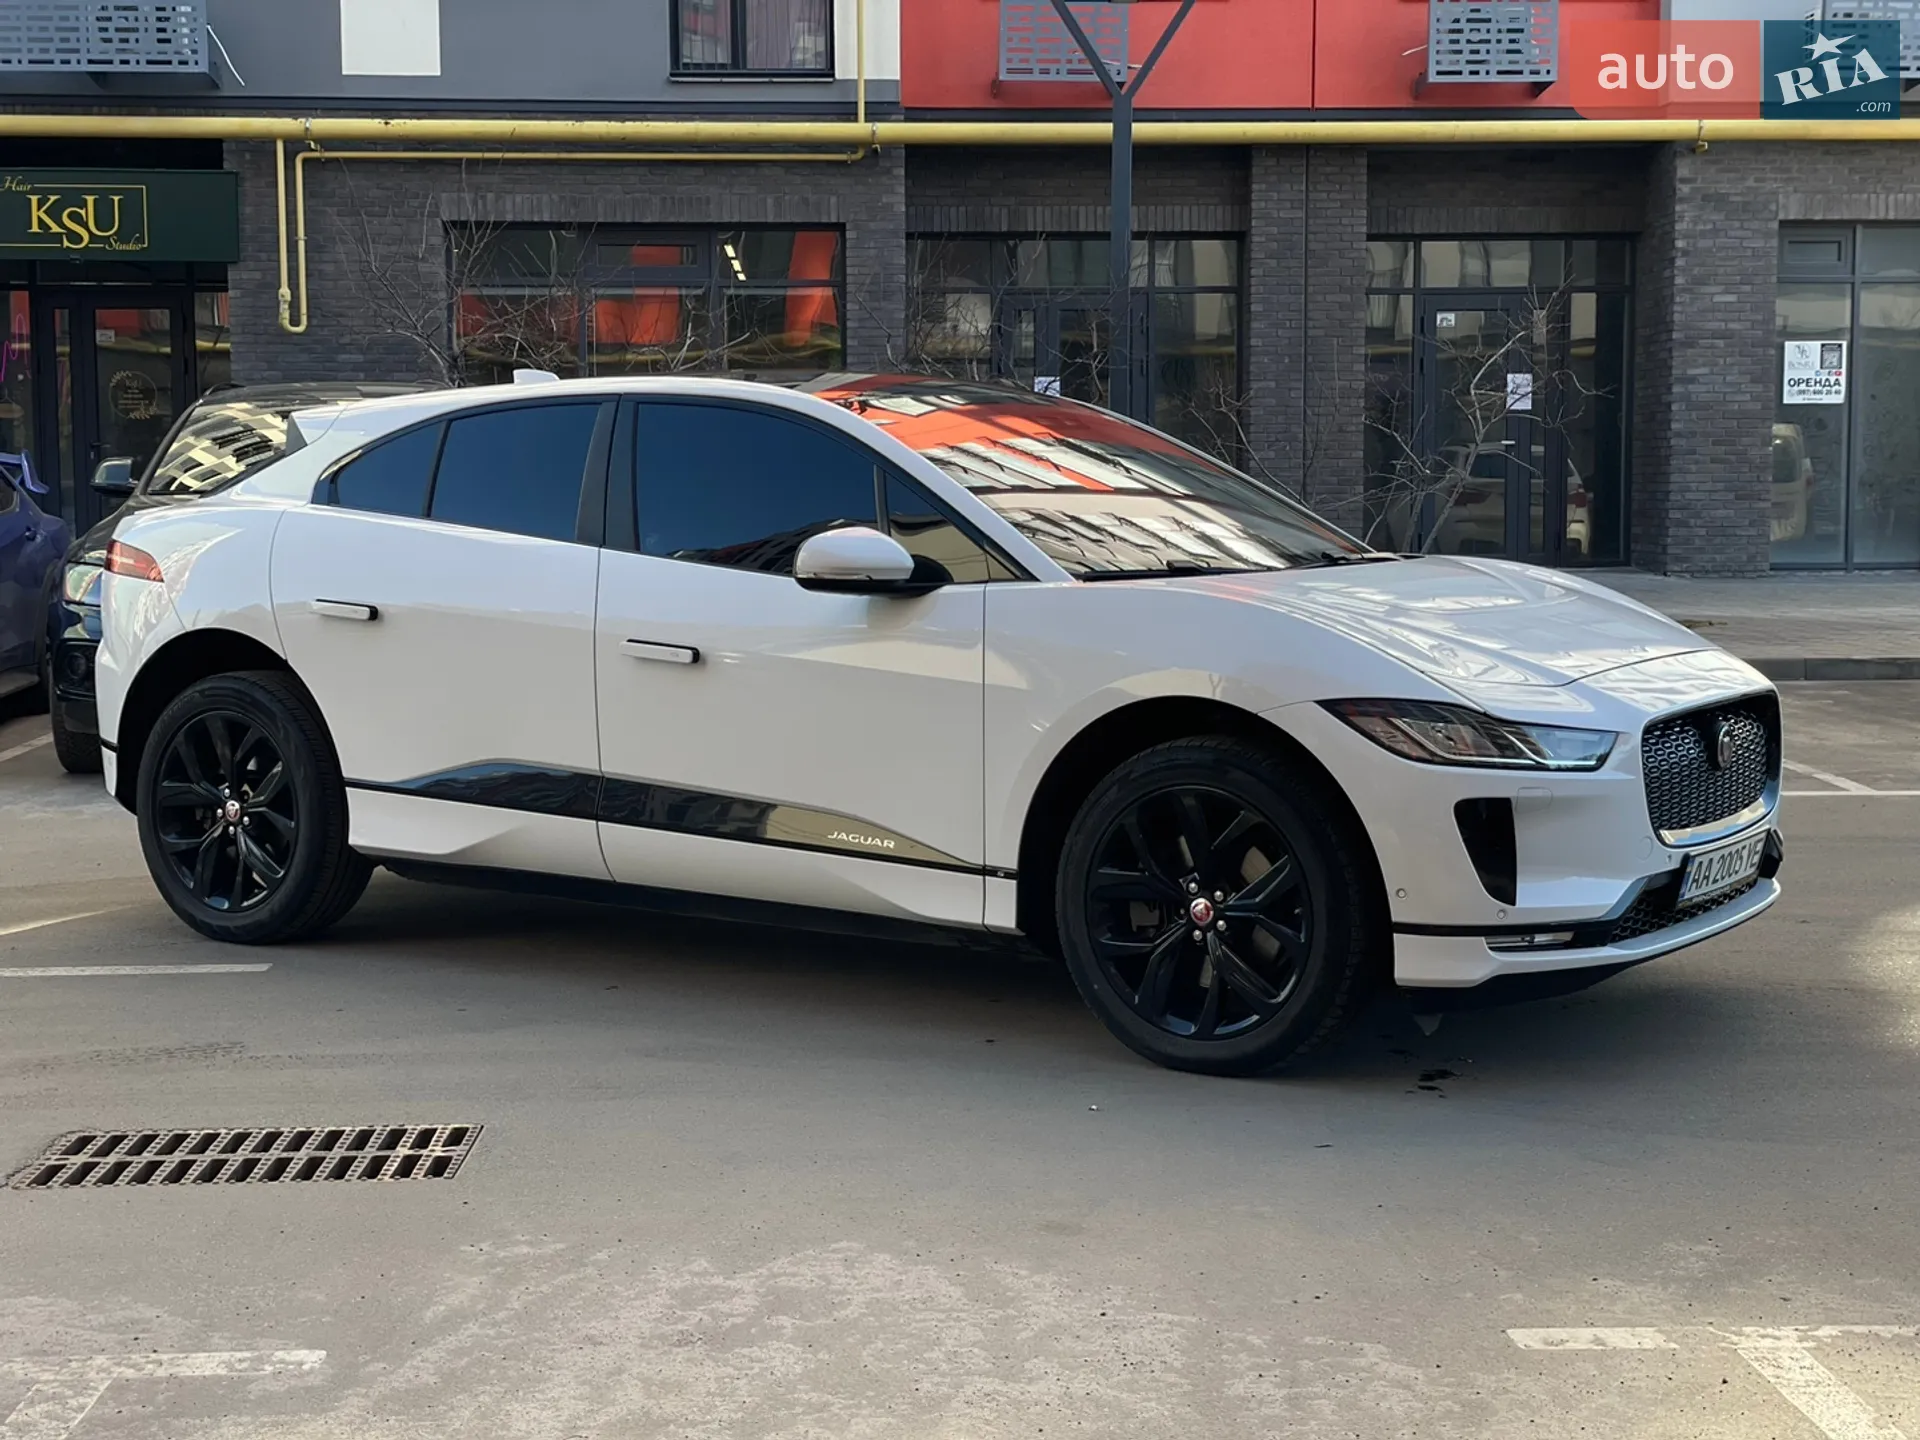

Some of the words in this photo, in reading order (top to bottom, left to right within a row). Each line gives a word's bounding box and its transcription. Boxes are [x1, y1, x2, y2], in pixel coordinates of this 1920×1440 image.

[0, 176, 32, 192] Hair
[26, 194, 124, 249] KSU
[105, 233, 142, 251] Studio
[1788, 377, 1841, 388] ОРЕНДА
[827, 831, 895, 848] JAGUAR
[1688, 858, 1713, 892] AA
[1712, 845, 1746, 884] 2005
